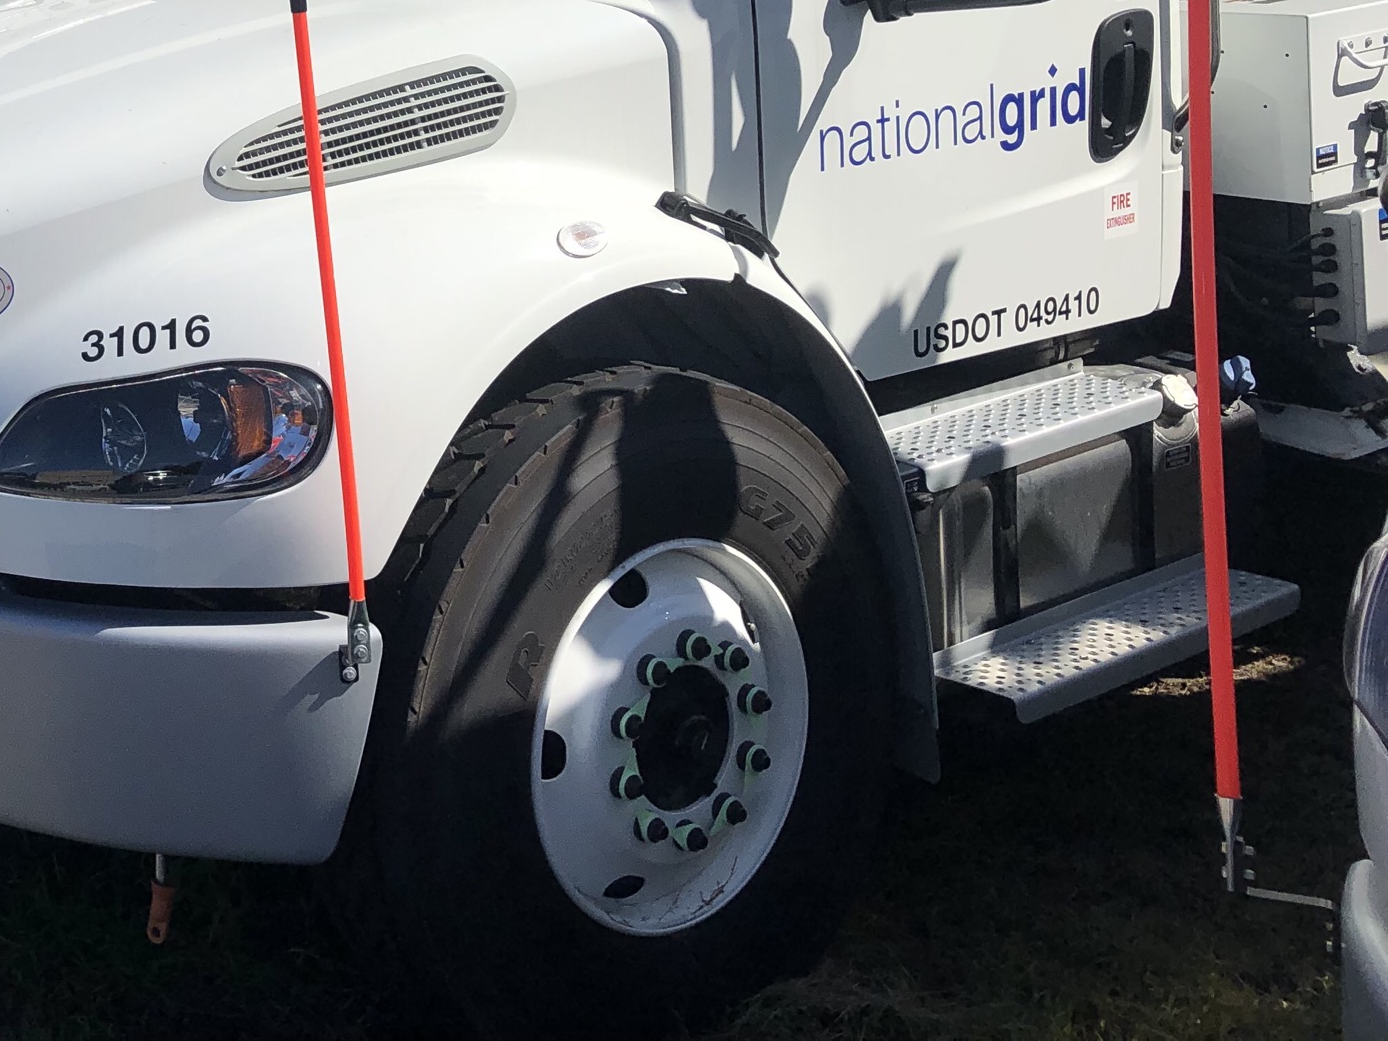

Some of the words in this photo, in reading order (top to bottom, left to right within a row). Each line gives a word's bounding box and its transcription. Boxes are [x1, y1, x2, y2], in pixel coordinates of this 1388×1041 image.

[819, 63, 1087, 172] nationalgrid
[1111, 191, 1131, 212] FIRE
[80, 314, 211, 363] 31016
[913, 307, 1008, 359] USDOT
[1014, 286, 1100, 332] 049410
